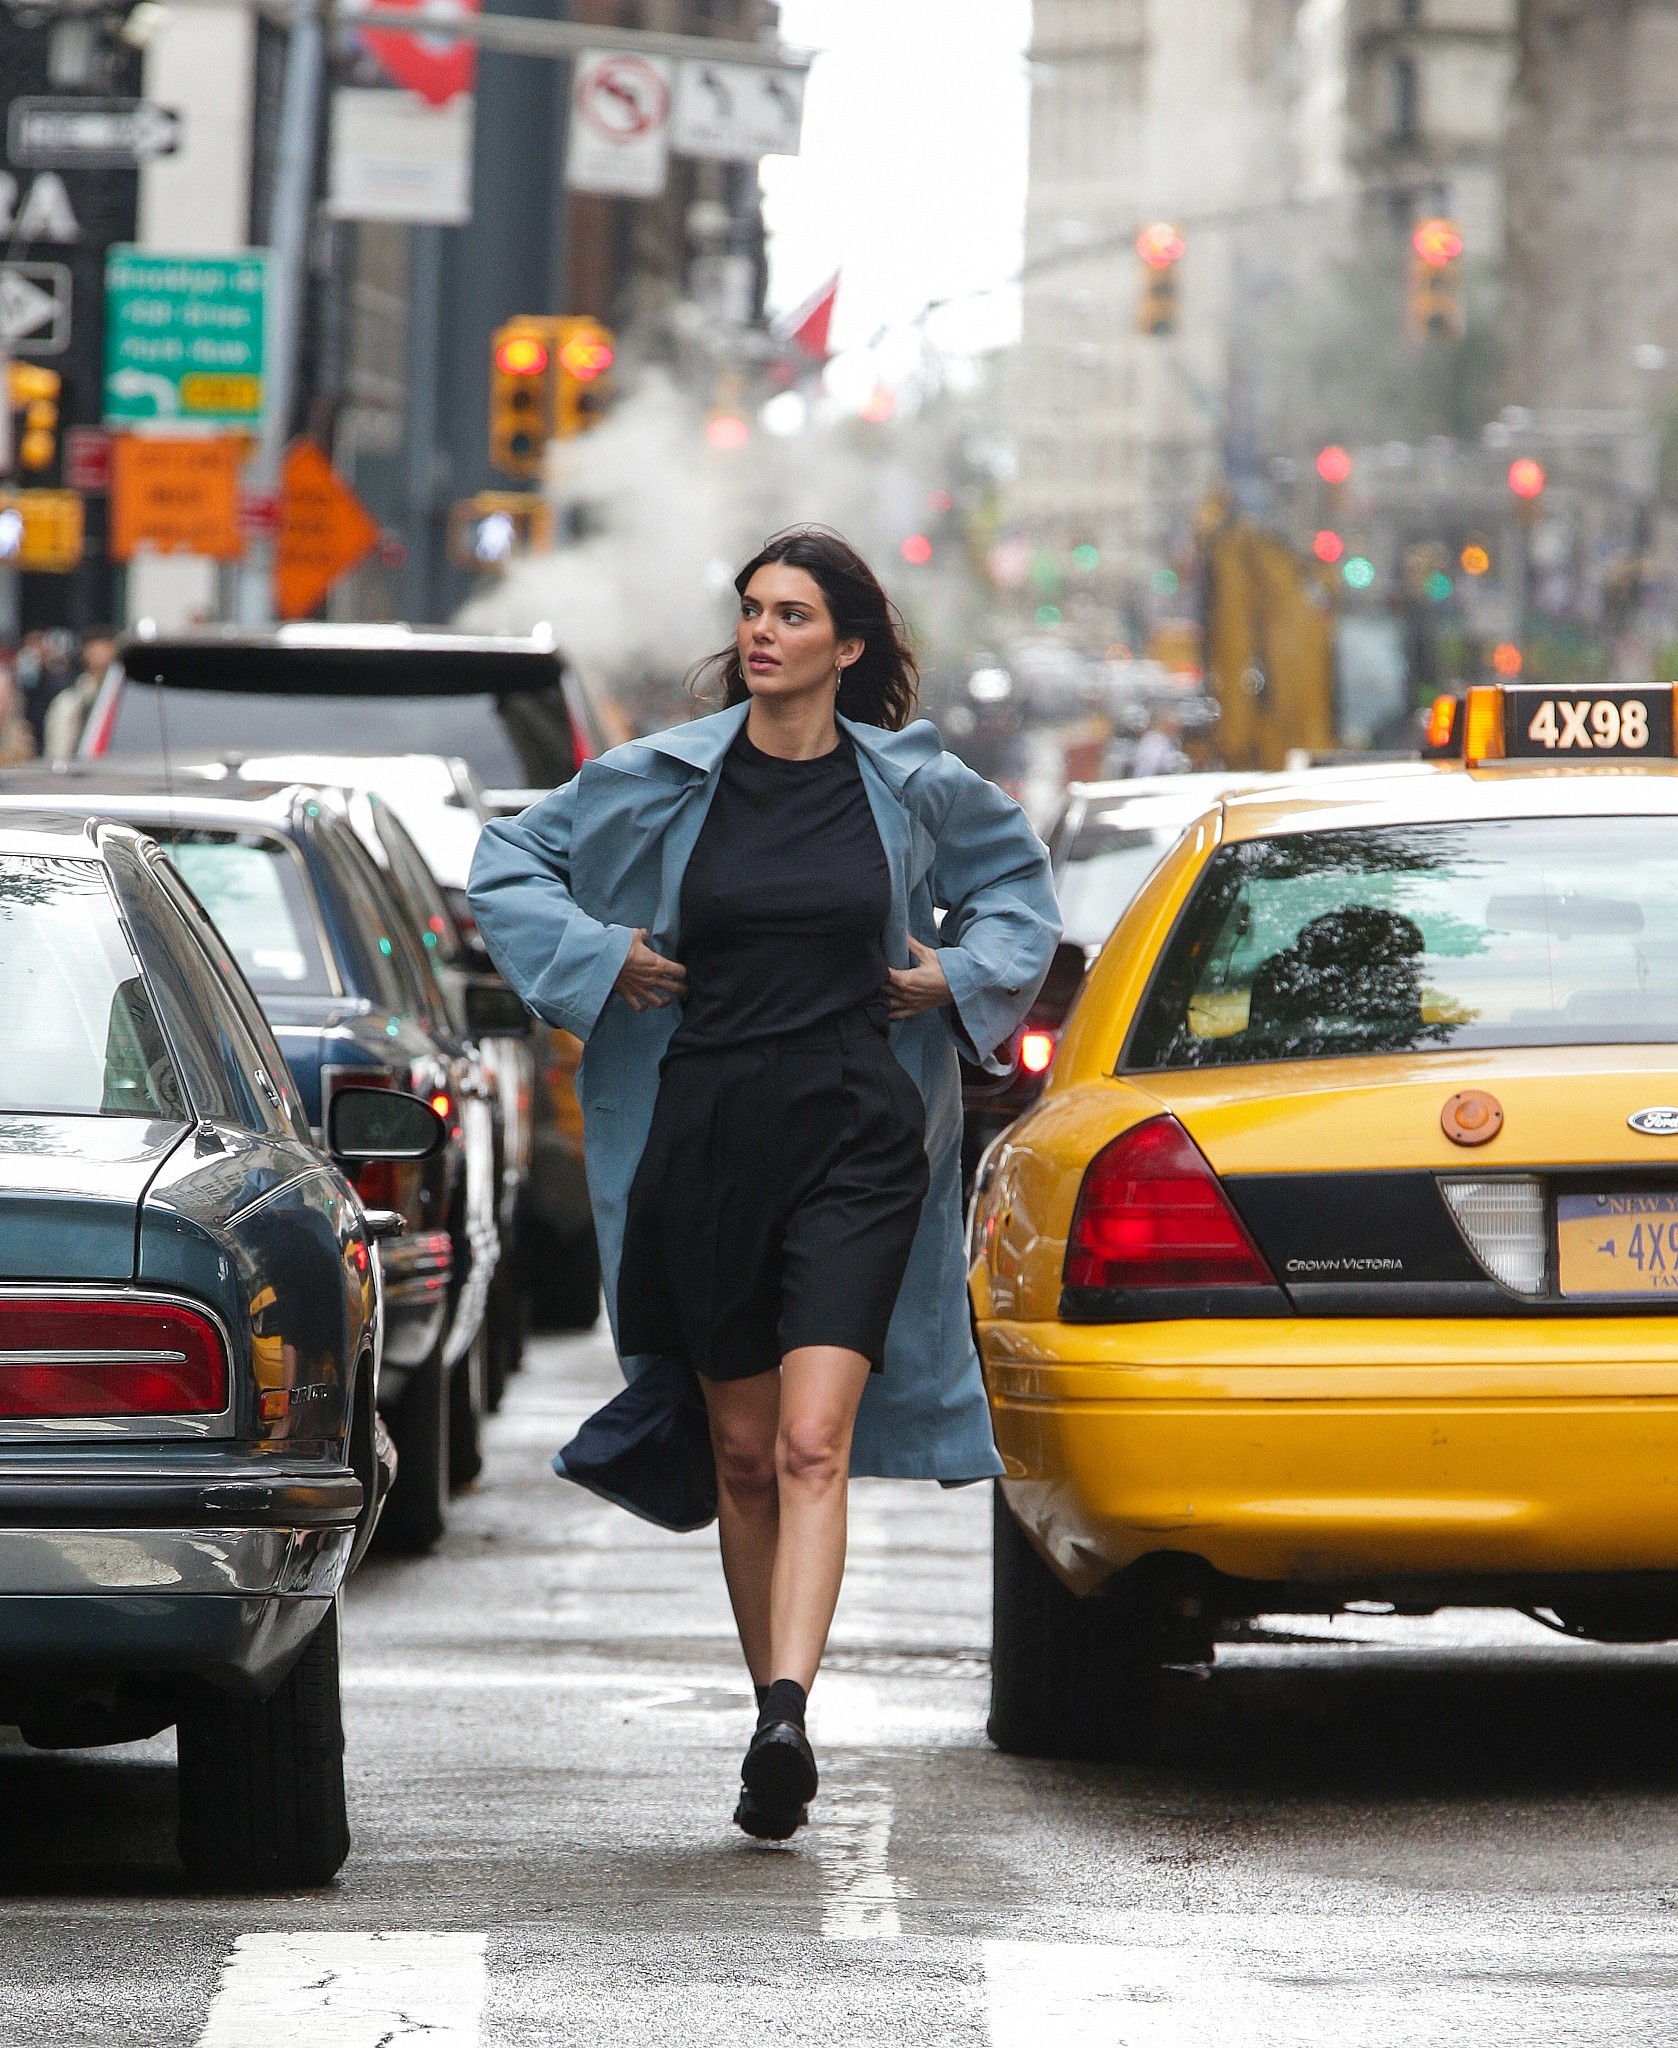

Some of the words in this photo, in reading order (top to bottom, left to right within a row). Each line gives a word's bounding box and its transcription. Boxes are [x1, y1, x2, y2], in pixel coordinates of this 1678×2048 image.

[1528, 700, 1649, 749] 4X98
[1609, 1197, 1661, 1215] NEW
[1286, 1259, 1340, 1272] CROWN
[1343, 1258, 1403, 1270] VICTORIA
